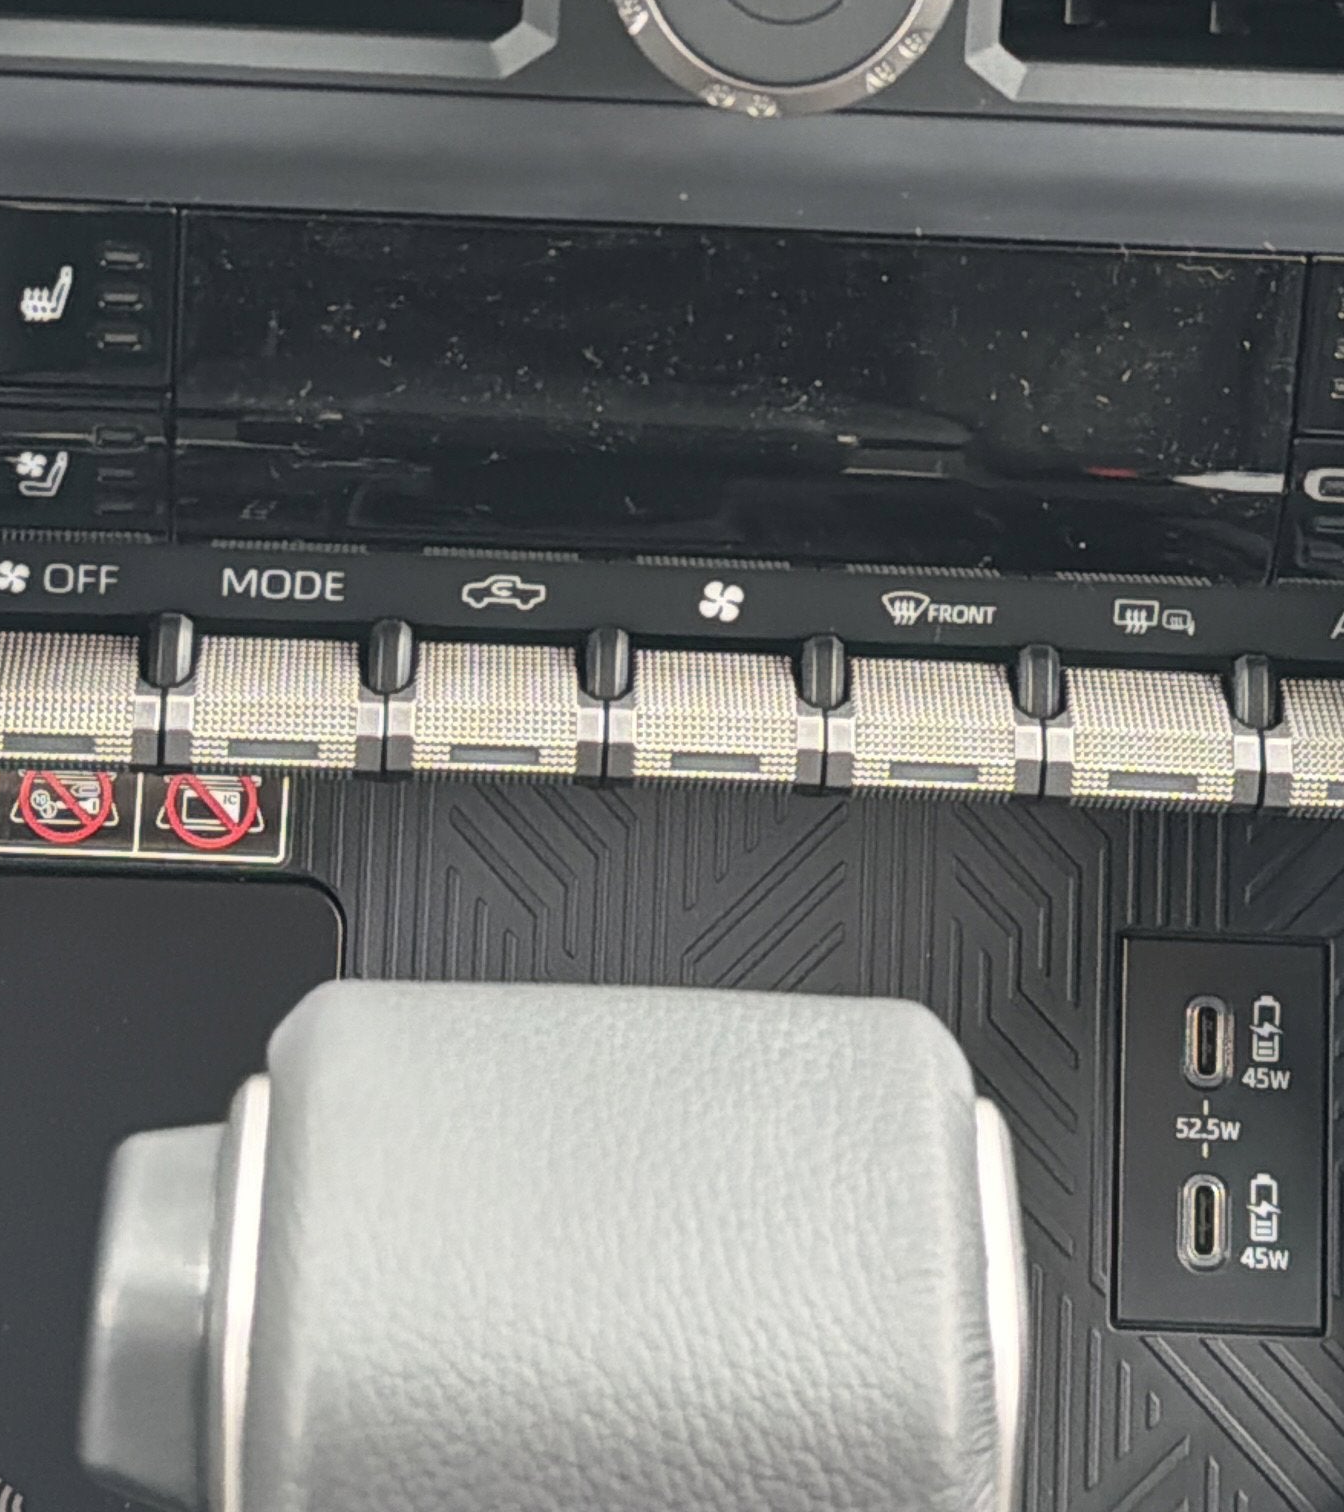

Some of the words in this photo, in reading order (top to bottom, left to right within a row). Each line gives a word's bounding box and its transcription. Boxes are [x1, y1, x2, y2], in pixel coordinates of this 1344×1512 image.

[42, 562, 121, 595] OFF
[219, 569, 346, 603] MODE
[926, 603, 997, 626] FRONT
[1241, 1067, 1292, 1090] 45W
[1175, 1117, 1241, 1141] 52.5W
[1239, 1247, 1290, 1271] 45W
